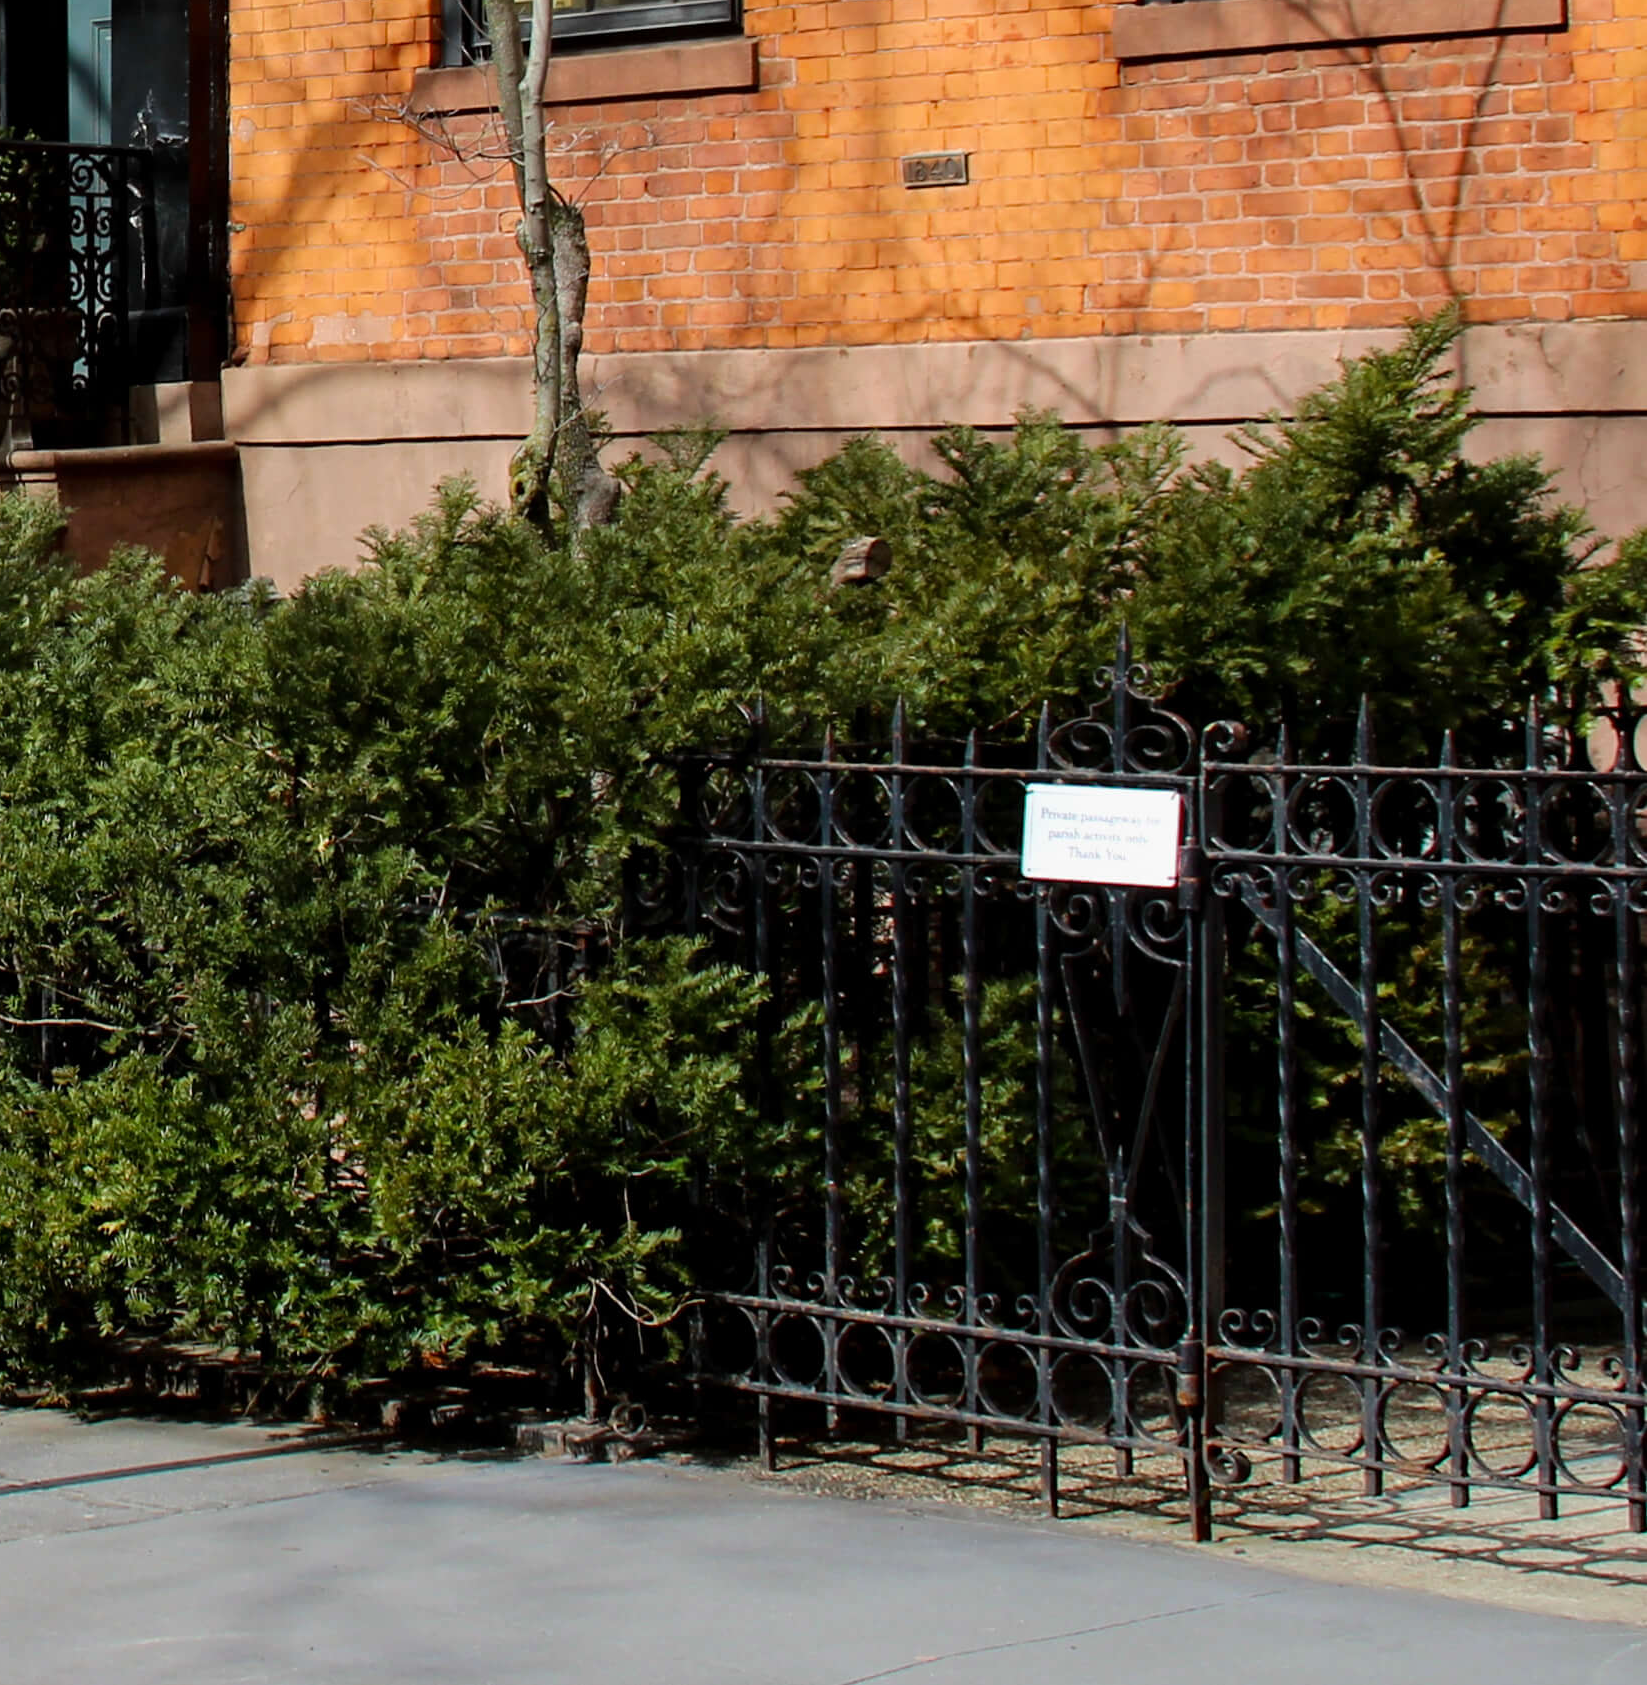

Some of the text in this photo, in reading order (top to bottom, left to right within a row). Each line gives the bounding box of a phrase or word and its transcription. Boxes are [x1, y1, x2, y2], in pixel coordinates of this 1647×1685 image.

[1041, 807, 1077, 820] Private
[1048, 828, 1080, 841] parish
[1067, 846, 1101, 860] Thank
